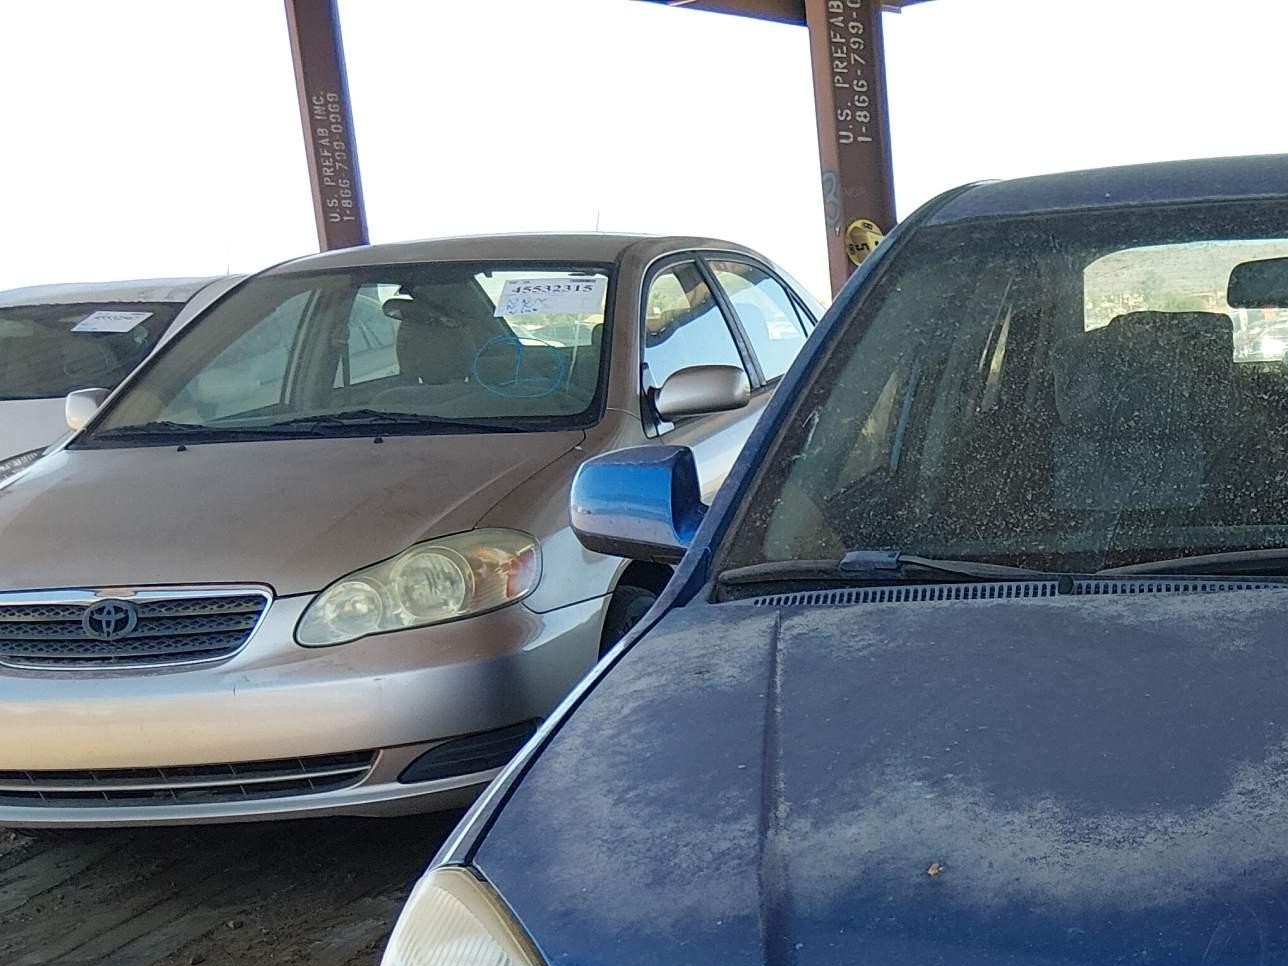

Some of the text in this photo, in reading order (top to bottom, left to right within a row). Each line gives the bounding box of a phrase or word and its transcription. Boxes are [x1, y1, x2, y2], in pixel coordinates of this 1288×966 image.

[828, 0, 854, 144] U.S. PREFAB
[312, 91, 341, 222] U.S. PREFAB INC.
[326, 93, 355, 221] 1-866-799-0969
